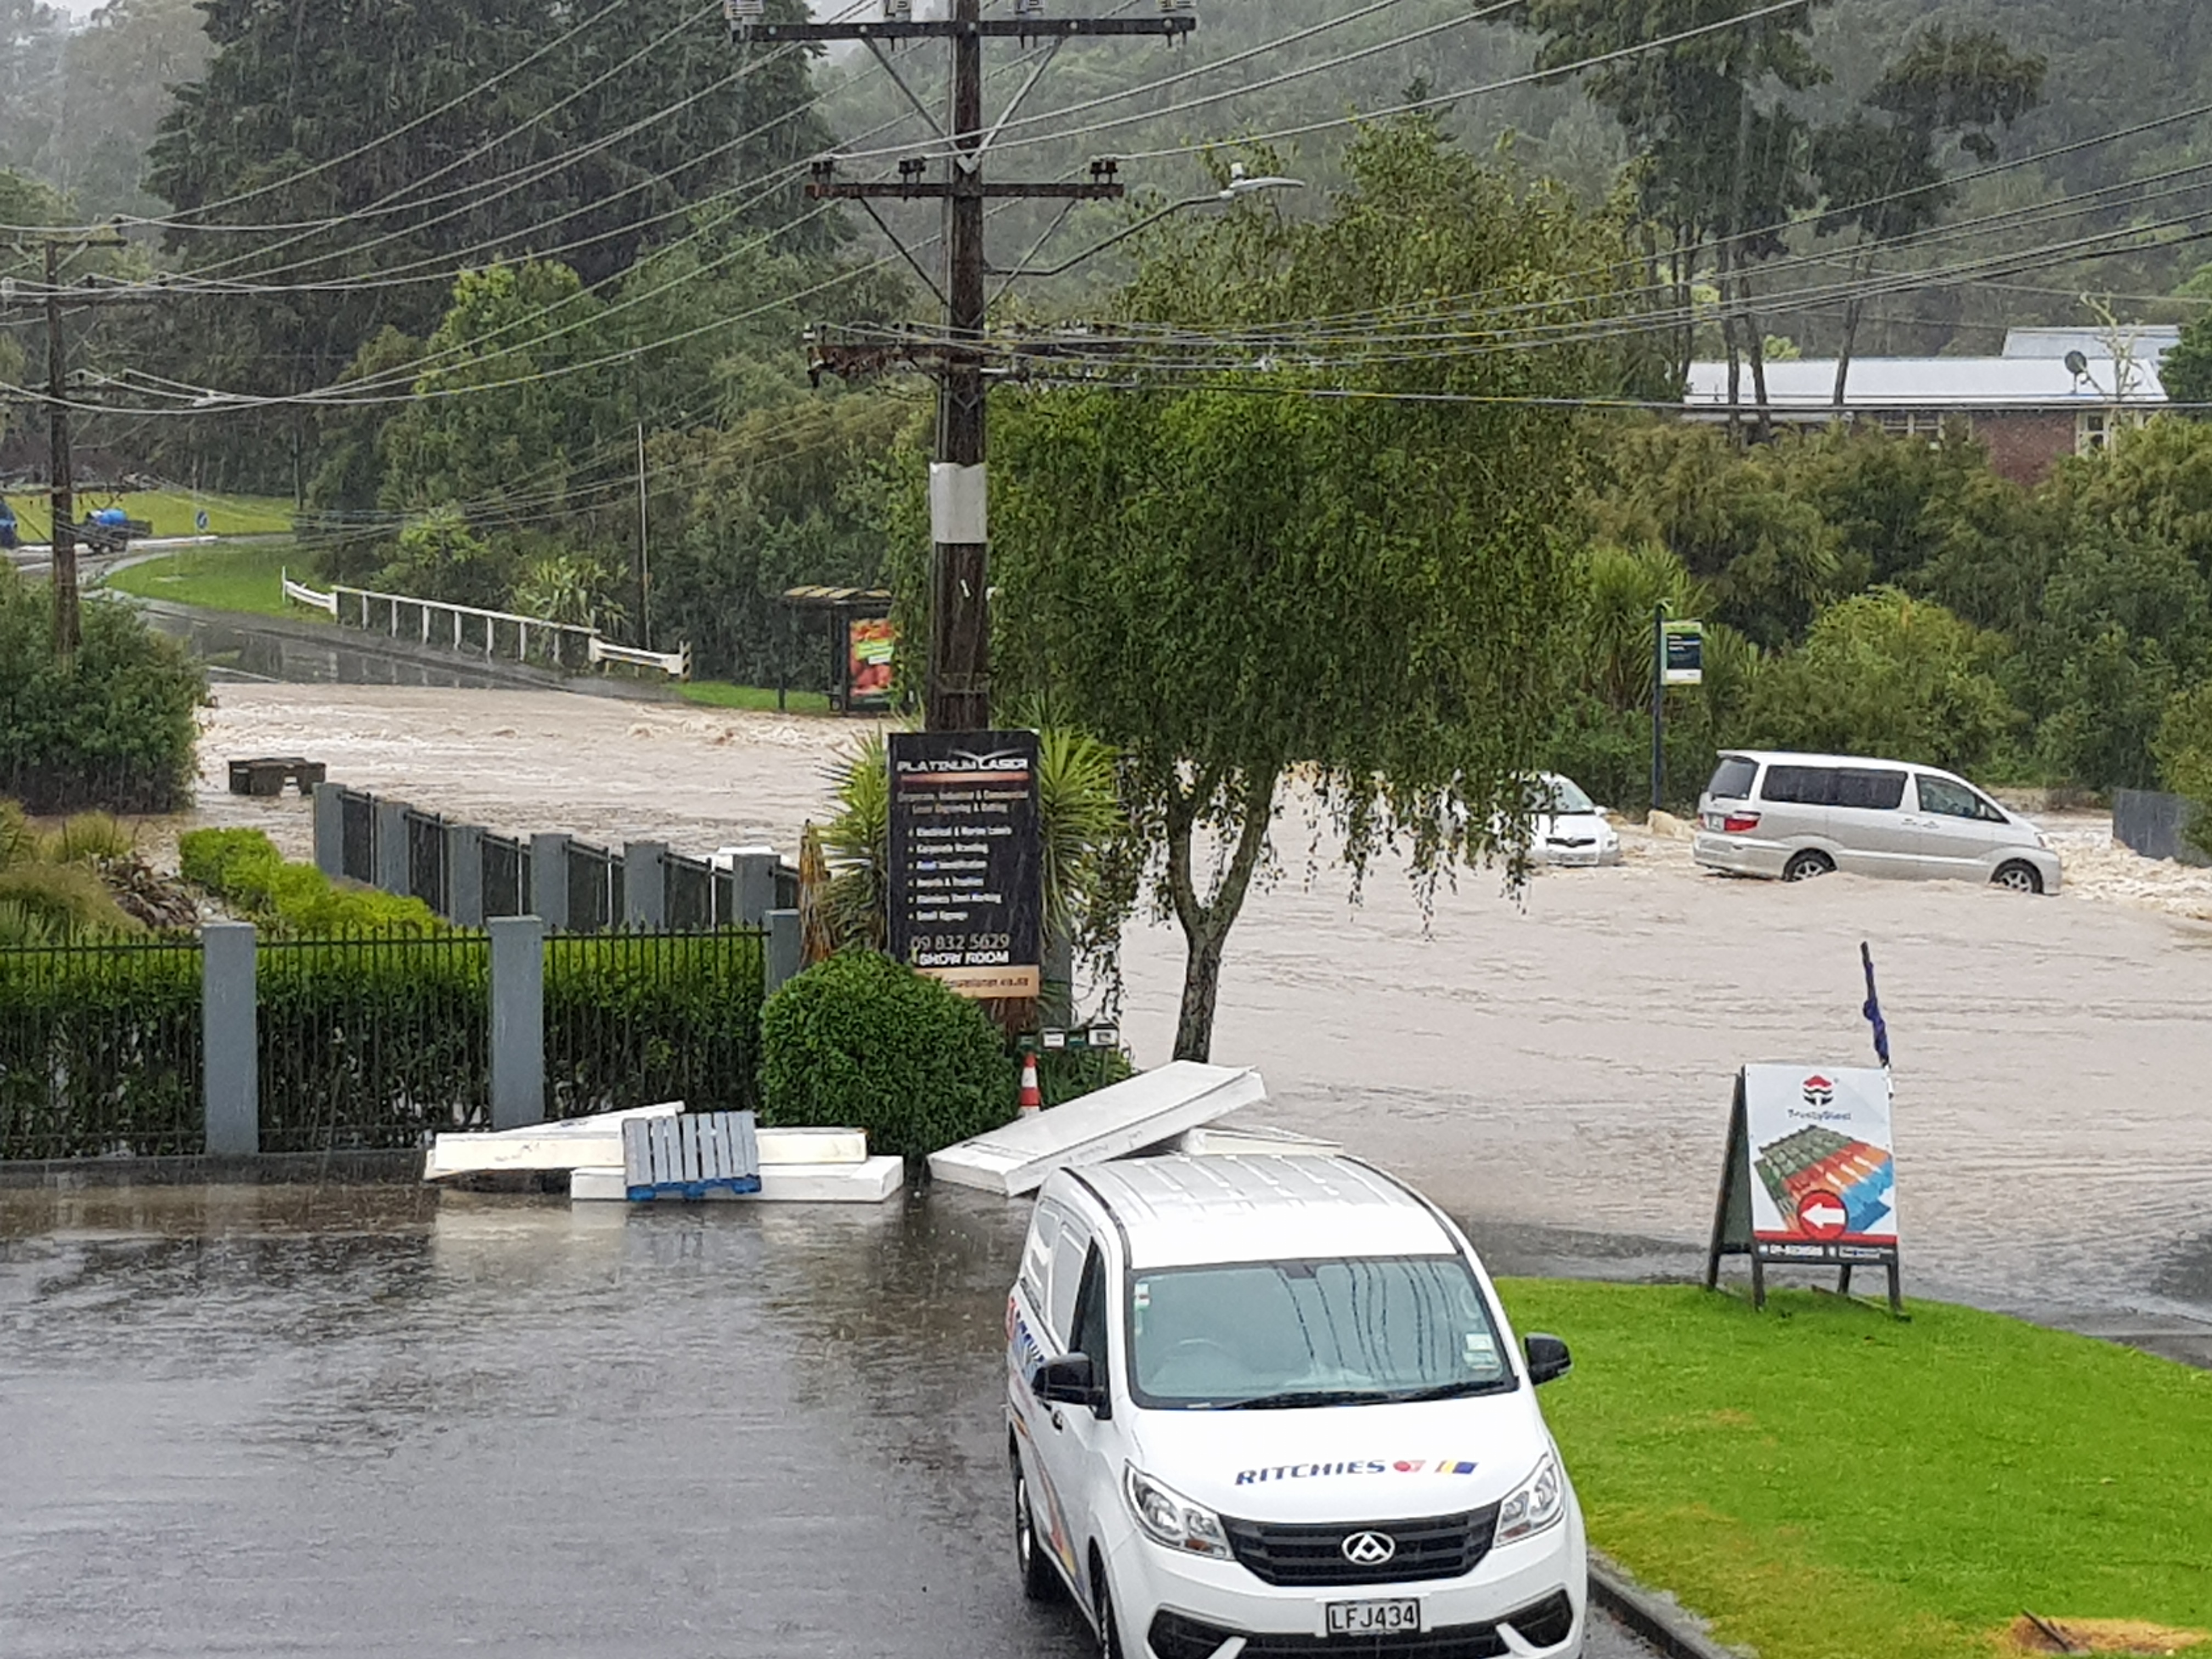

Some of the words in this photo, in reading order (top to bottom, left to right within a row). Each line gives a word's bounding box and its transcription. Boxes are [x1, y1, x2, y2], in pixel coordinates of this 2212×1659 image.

[896, 760, 977, 772] PLATINUM
[910, 936, 931, 951] 09
[935, 935, 965, 950] 832
[919, 952, 962, 966] SHOW
[964, 950, 1009, 964] ROOM
[1234, 1459, 1386, 1485] RITCHIES
[1331, 1605, 1415, 1629] LFJ434
